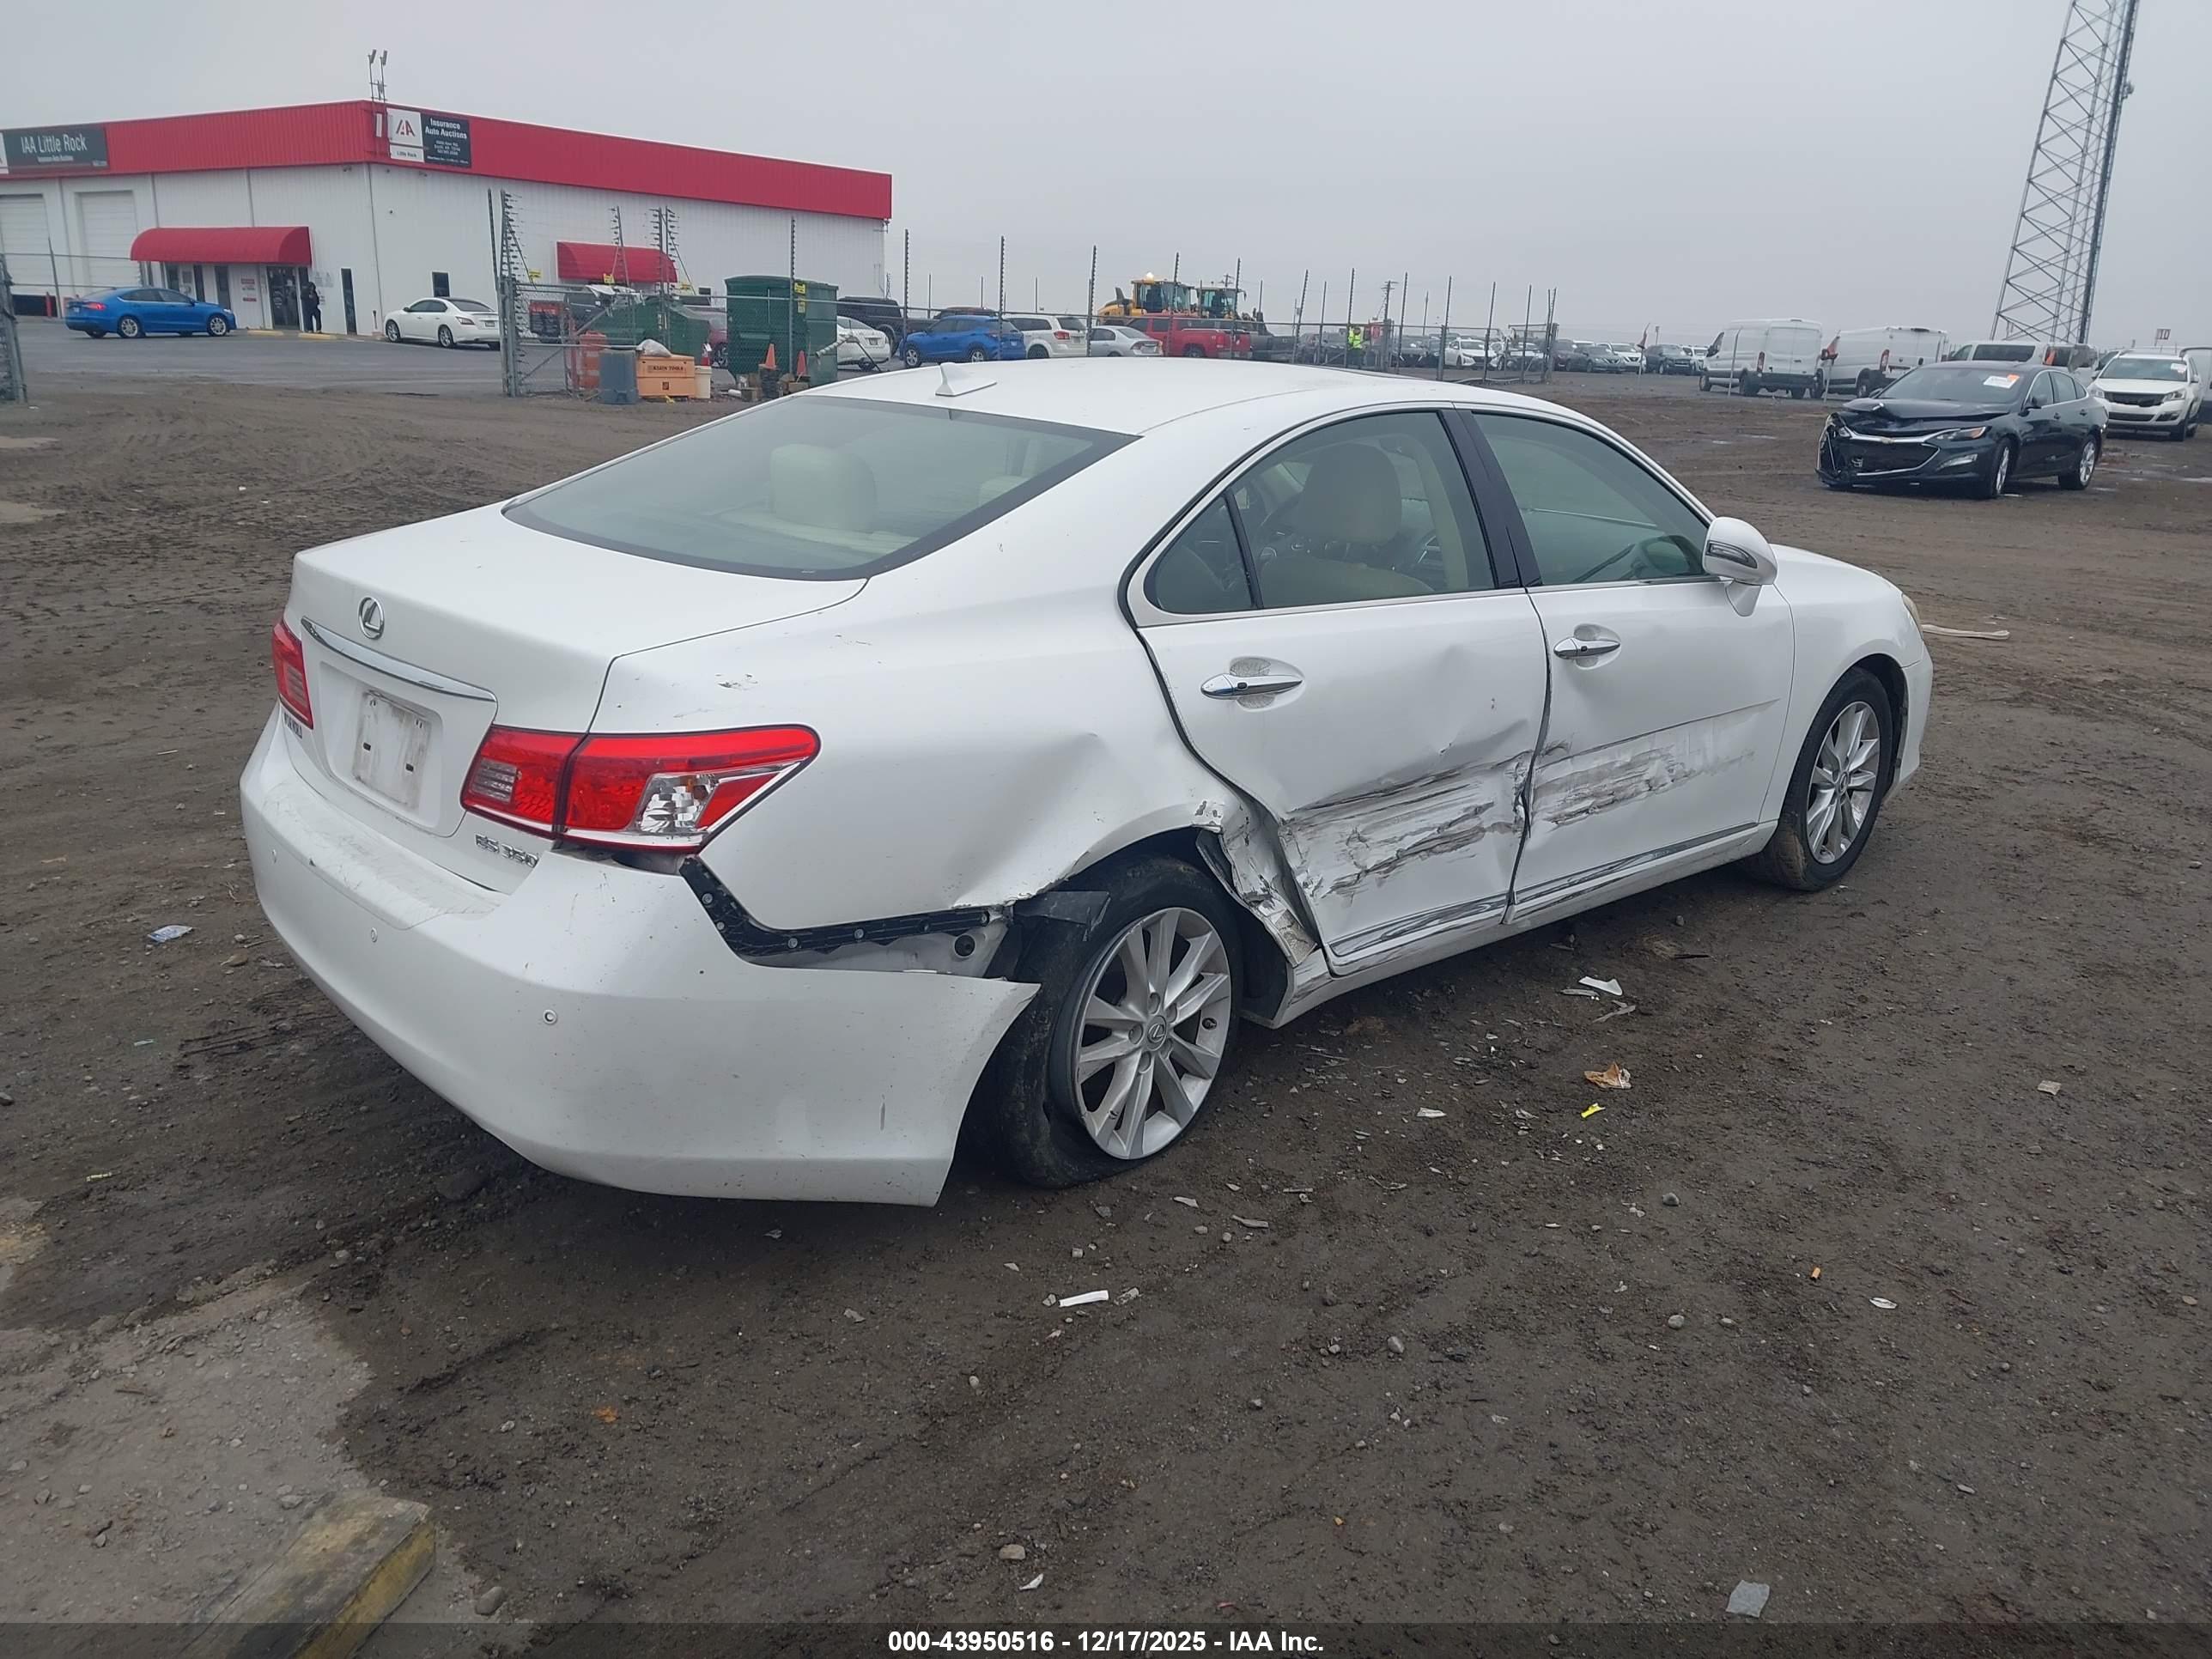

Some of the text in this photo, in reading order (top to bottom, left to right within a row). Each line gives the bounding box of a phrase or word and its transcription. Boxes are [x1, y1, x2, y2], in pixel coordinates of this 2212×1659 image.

[430, 118, 460, 130] Insurance
[425, 125, 467, 139] Auto Auctions
[21, 133, 88, 154] IAA Little Rock
